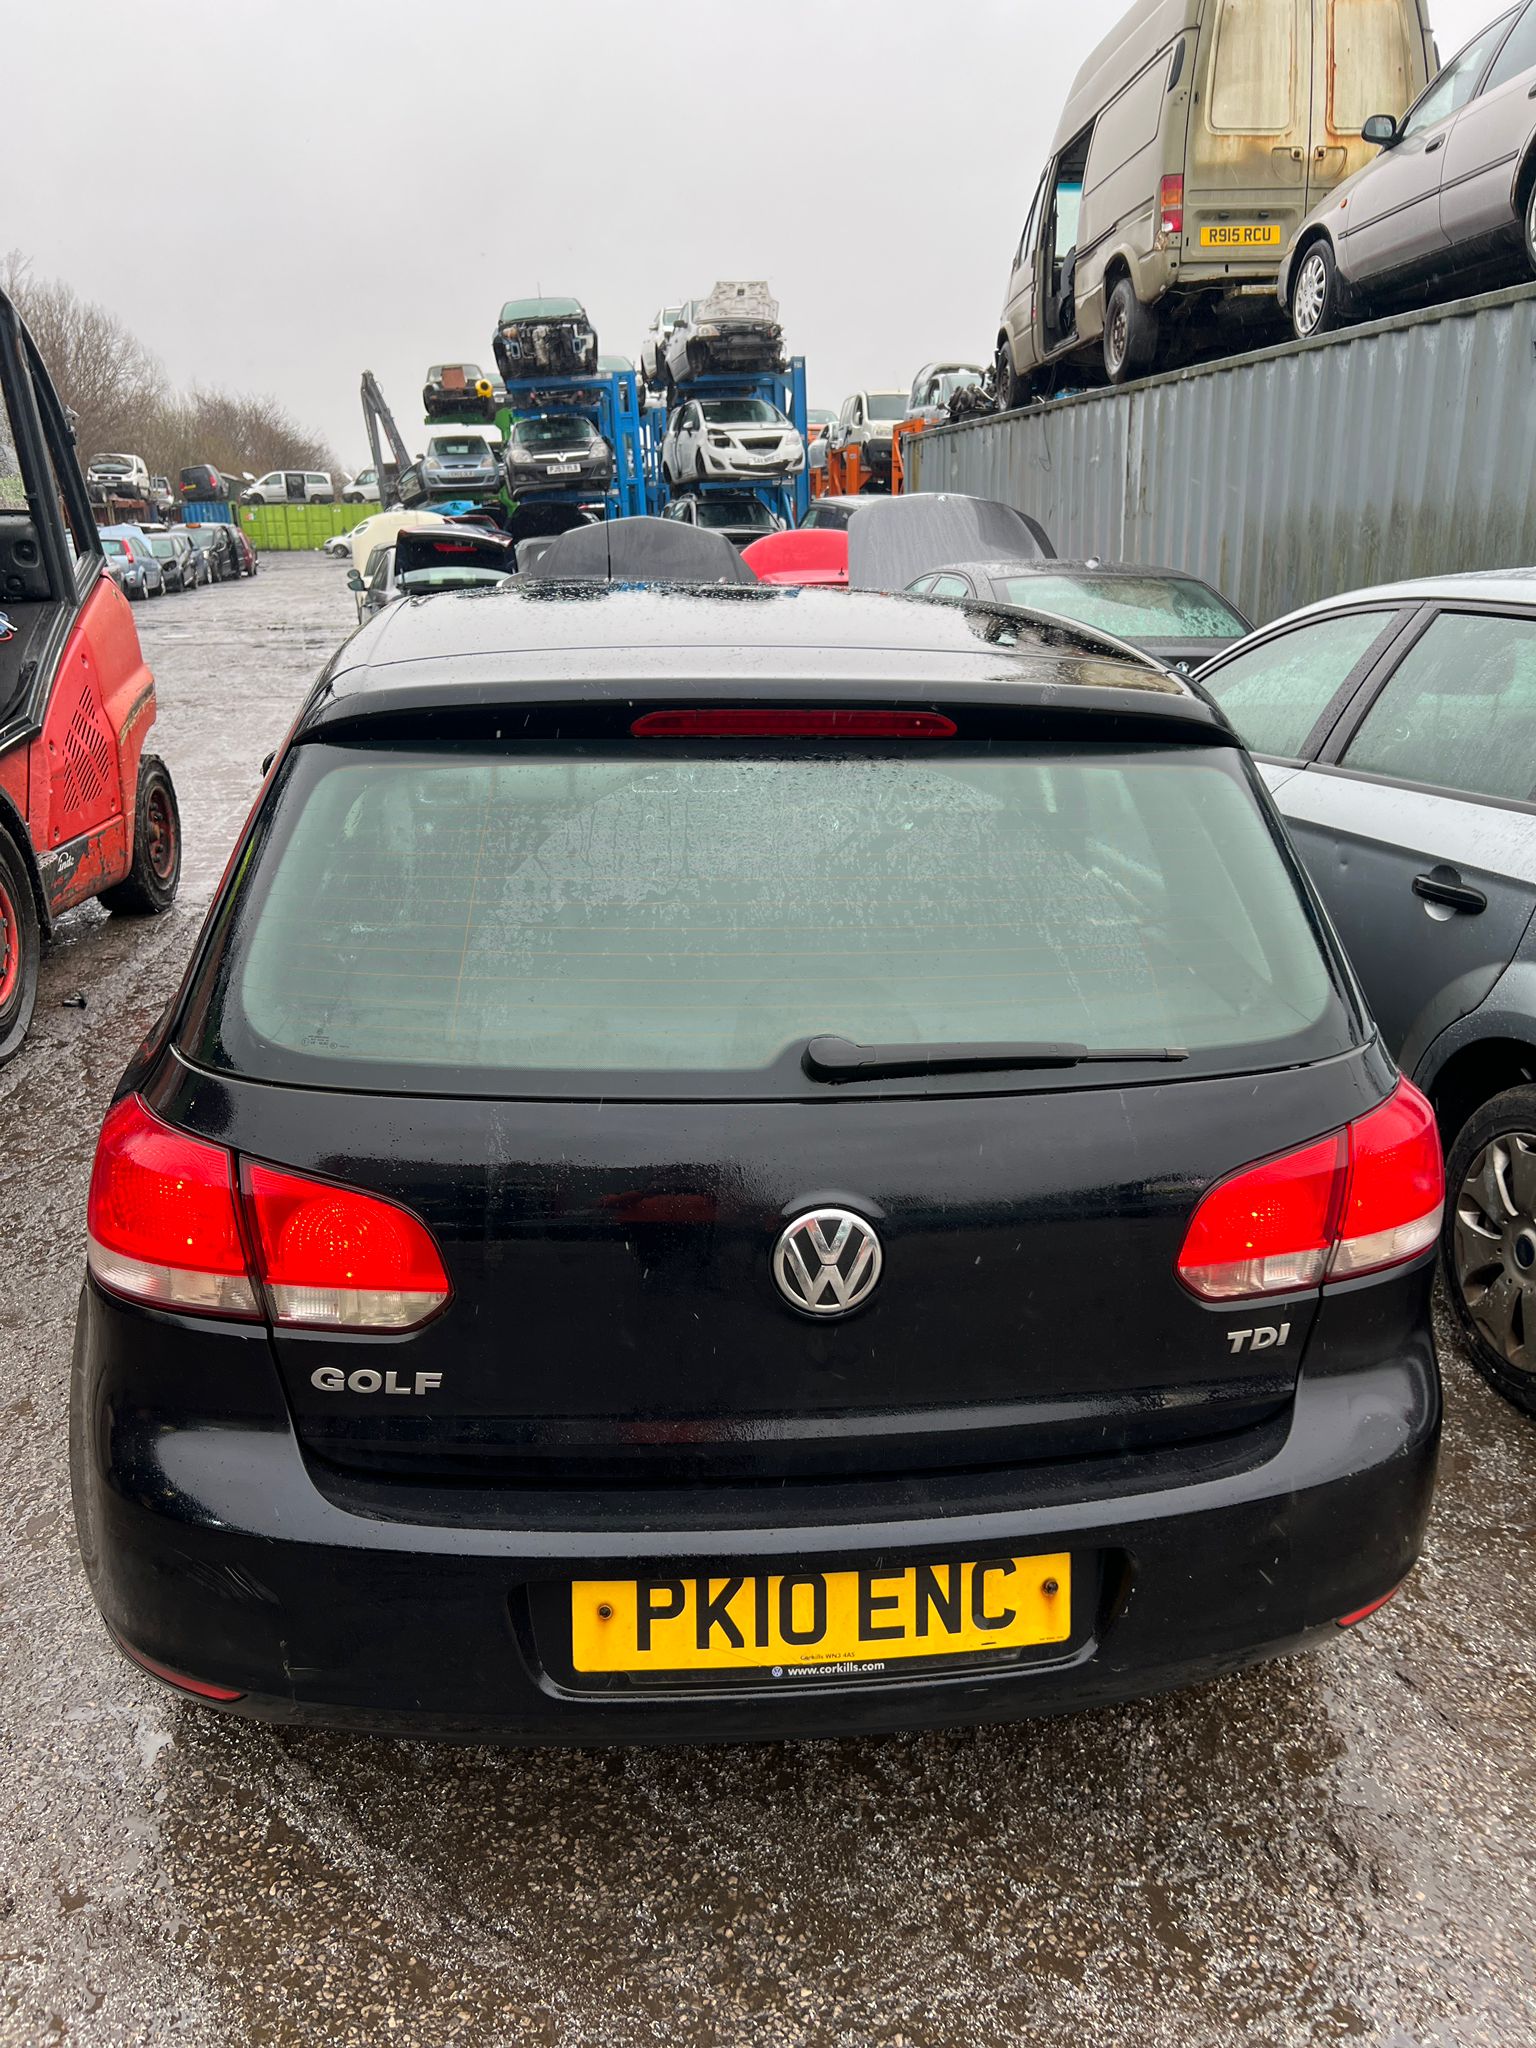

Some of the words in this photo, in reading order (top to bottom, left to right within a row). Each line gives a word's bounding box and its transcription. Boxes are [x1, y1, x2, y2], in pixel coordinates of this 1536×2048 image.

[1209, 228, 1240, 243] R915
[1244, 227, 1271, 242] RCU
[1227, 1322, 1291, 1354] TDI
[310, 1366, 443, 1395] GOLF
[635, 1573, 828, 1651] PK10
[857, 1558, 1017, 1643] ENC
[787, 1661, 885, 1676] www.corkills.com
